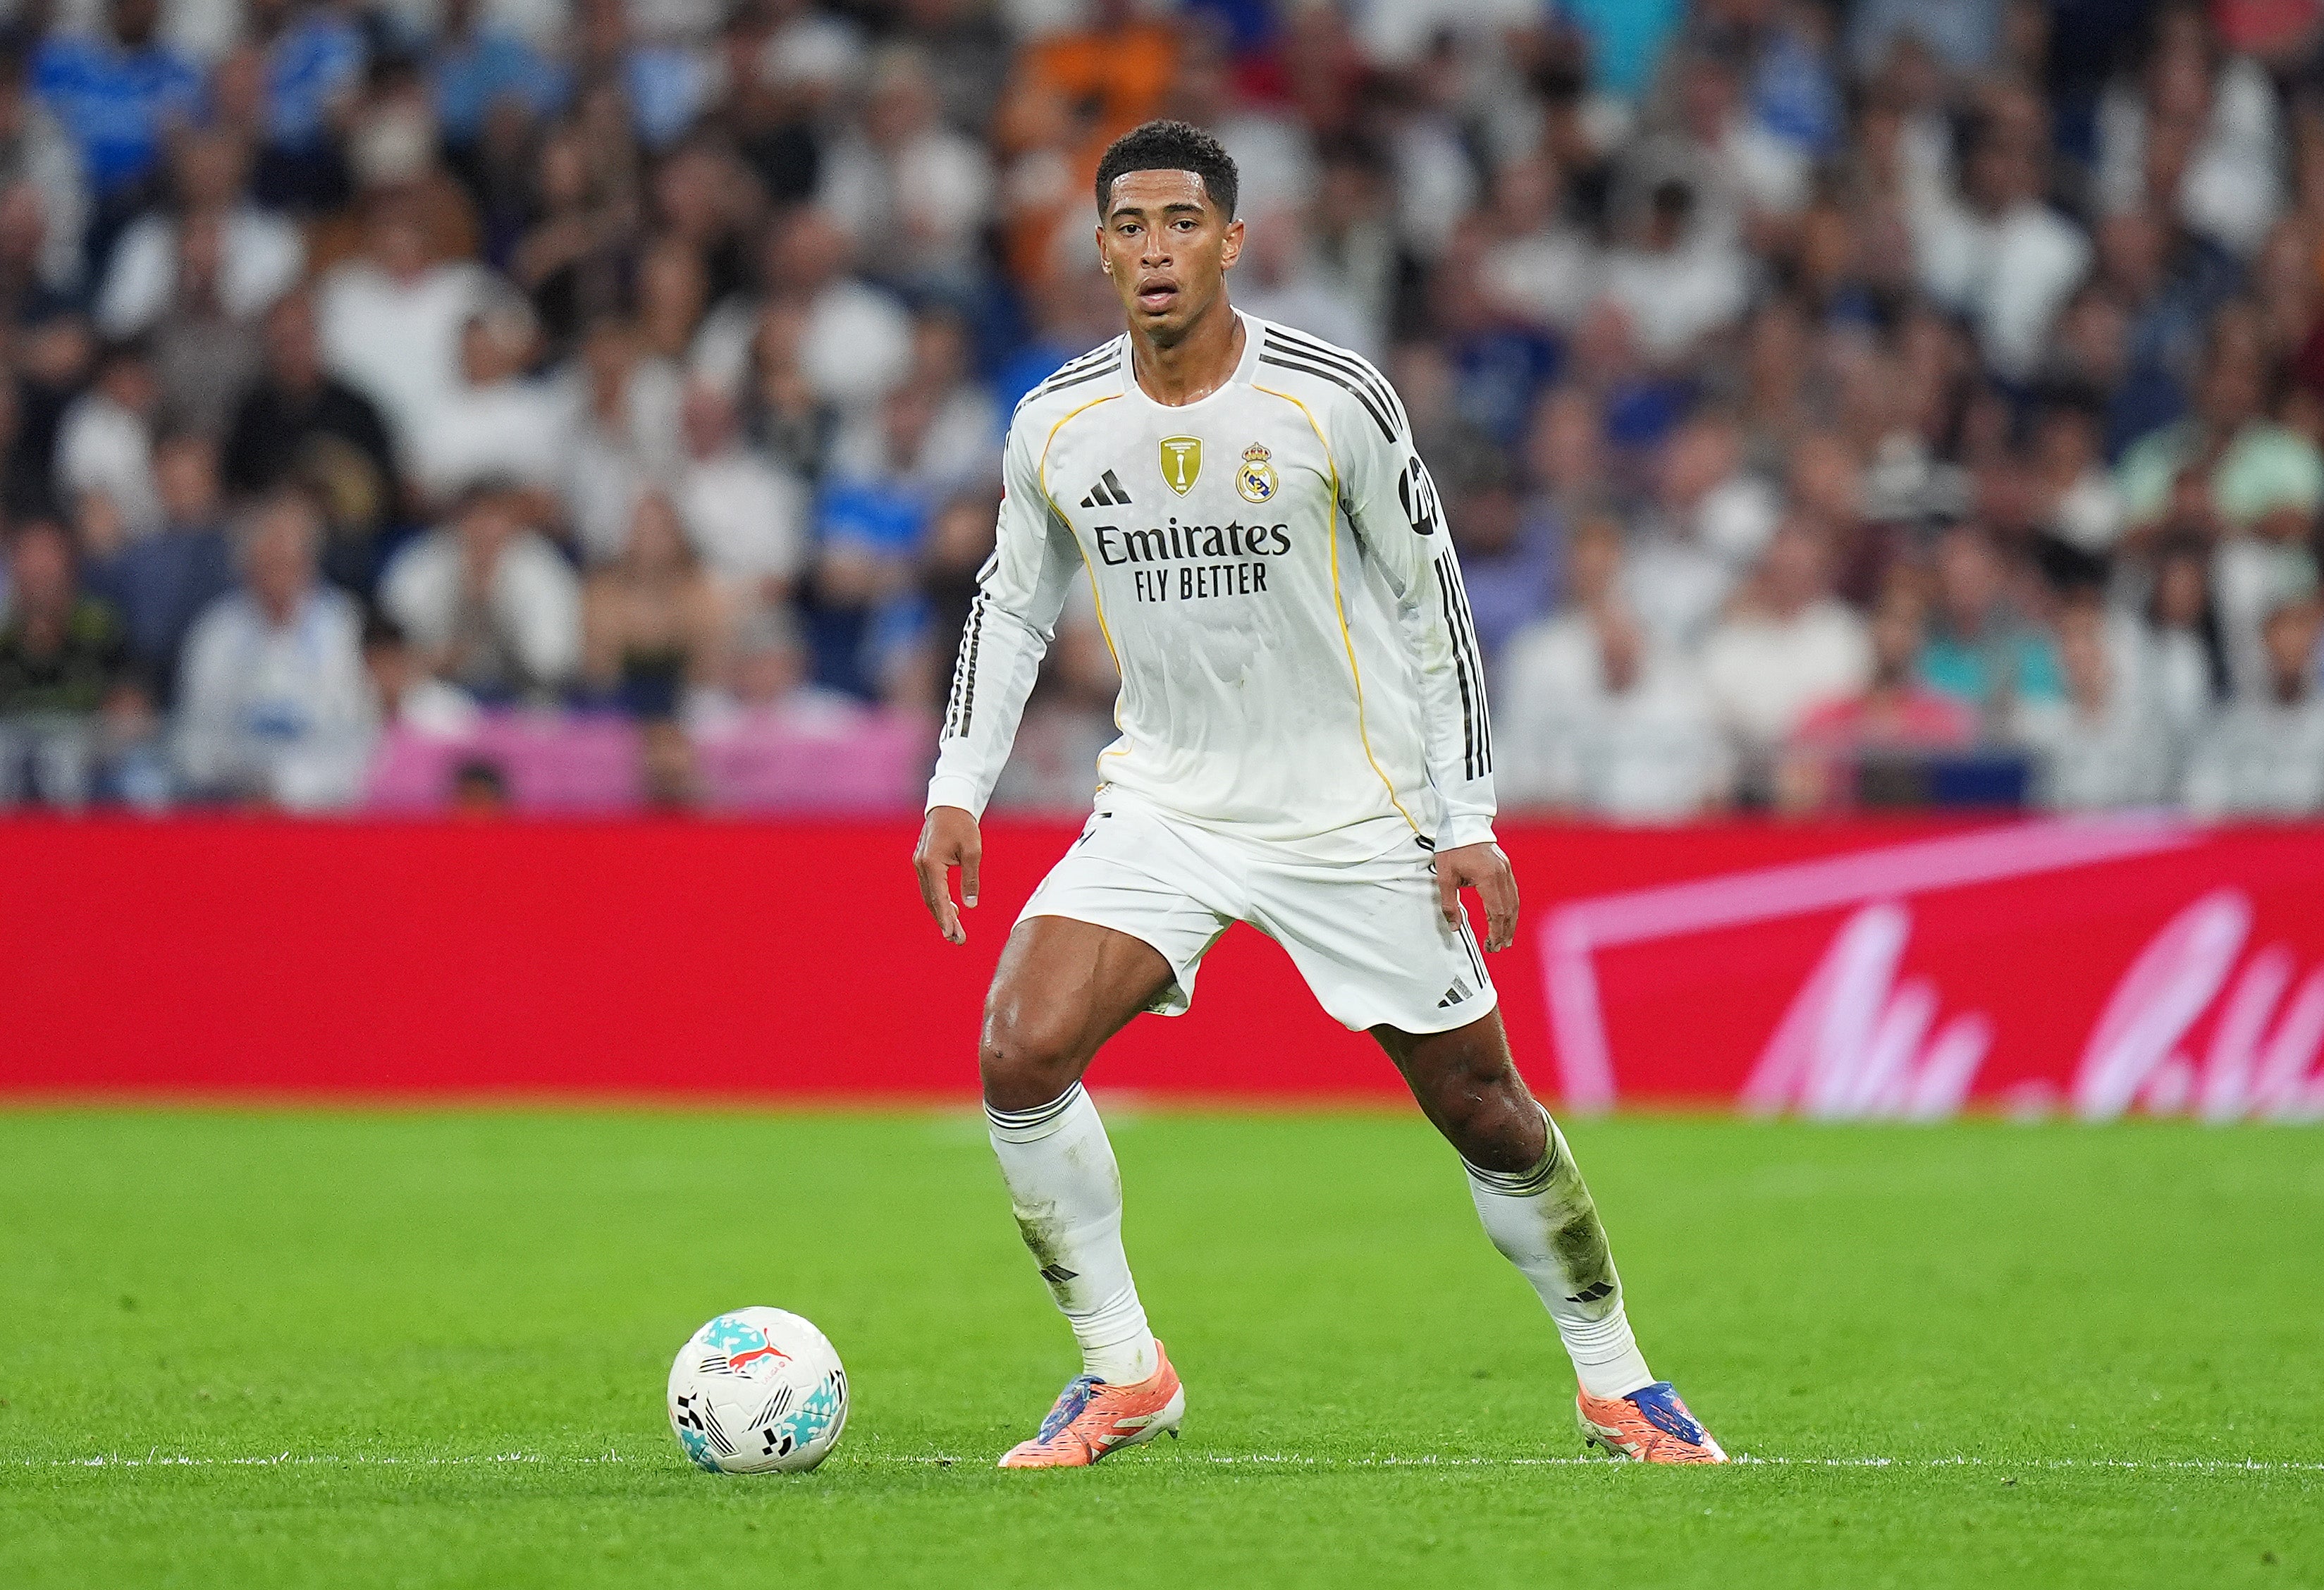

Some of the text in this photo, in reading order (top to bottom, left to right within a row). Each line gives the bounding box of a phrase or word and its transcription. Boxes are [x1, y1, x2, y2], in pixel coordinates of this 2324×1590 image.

[1094, 517, 1291, 565] Emirates
[1135, 562, 1267, 602] FLY BETTER
